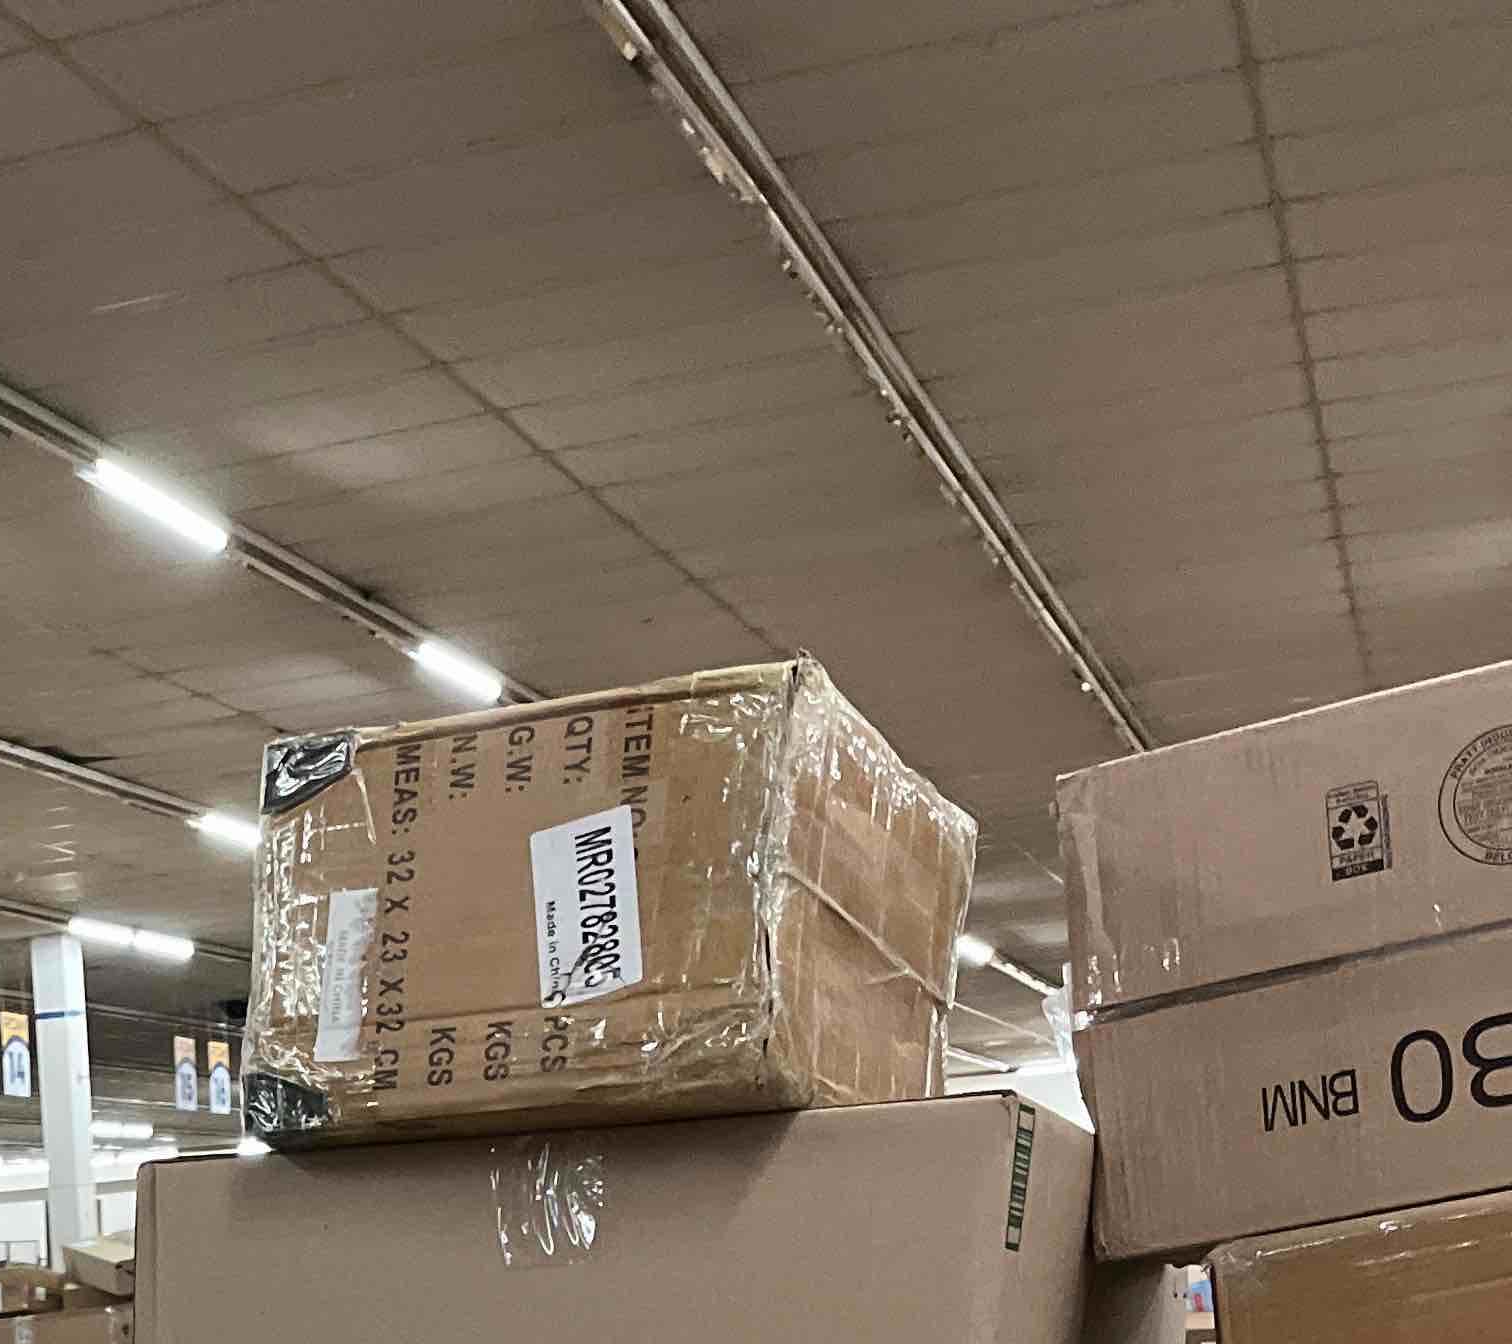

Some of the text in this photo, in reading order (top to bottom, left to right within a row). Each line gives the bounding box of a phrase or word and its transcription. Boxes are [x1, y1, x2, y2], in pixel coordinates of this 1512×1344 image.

[372, 743, 421, 1091] MEAS: 32 X 23 X 32 CM
[427, 734, 478, 1087] N.W: KGS
[483, 726, 535, 1082] G.W: KGS
[540, 716, 592, 1073] QTY: PCS
[546, 900, 556, 937] Made
[548, 941, 560, 954] in
[1261, 1069, 1360, 1132] BNM
